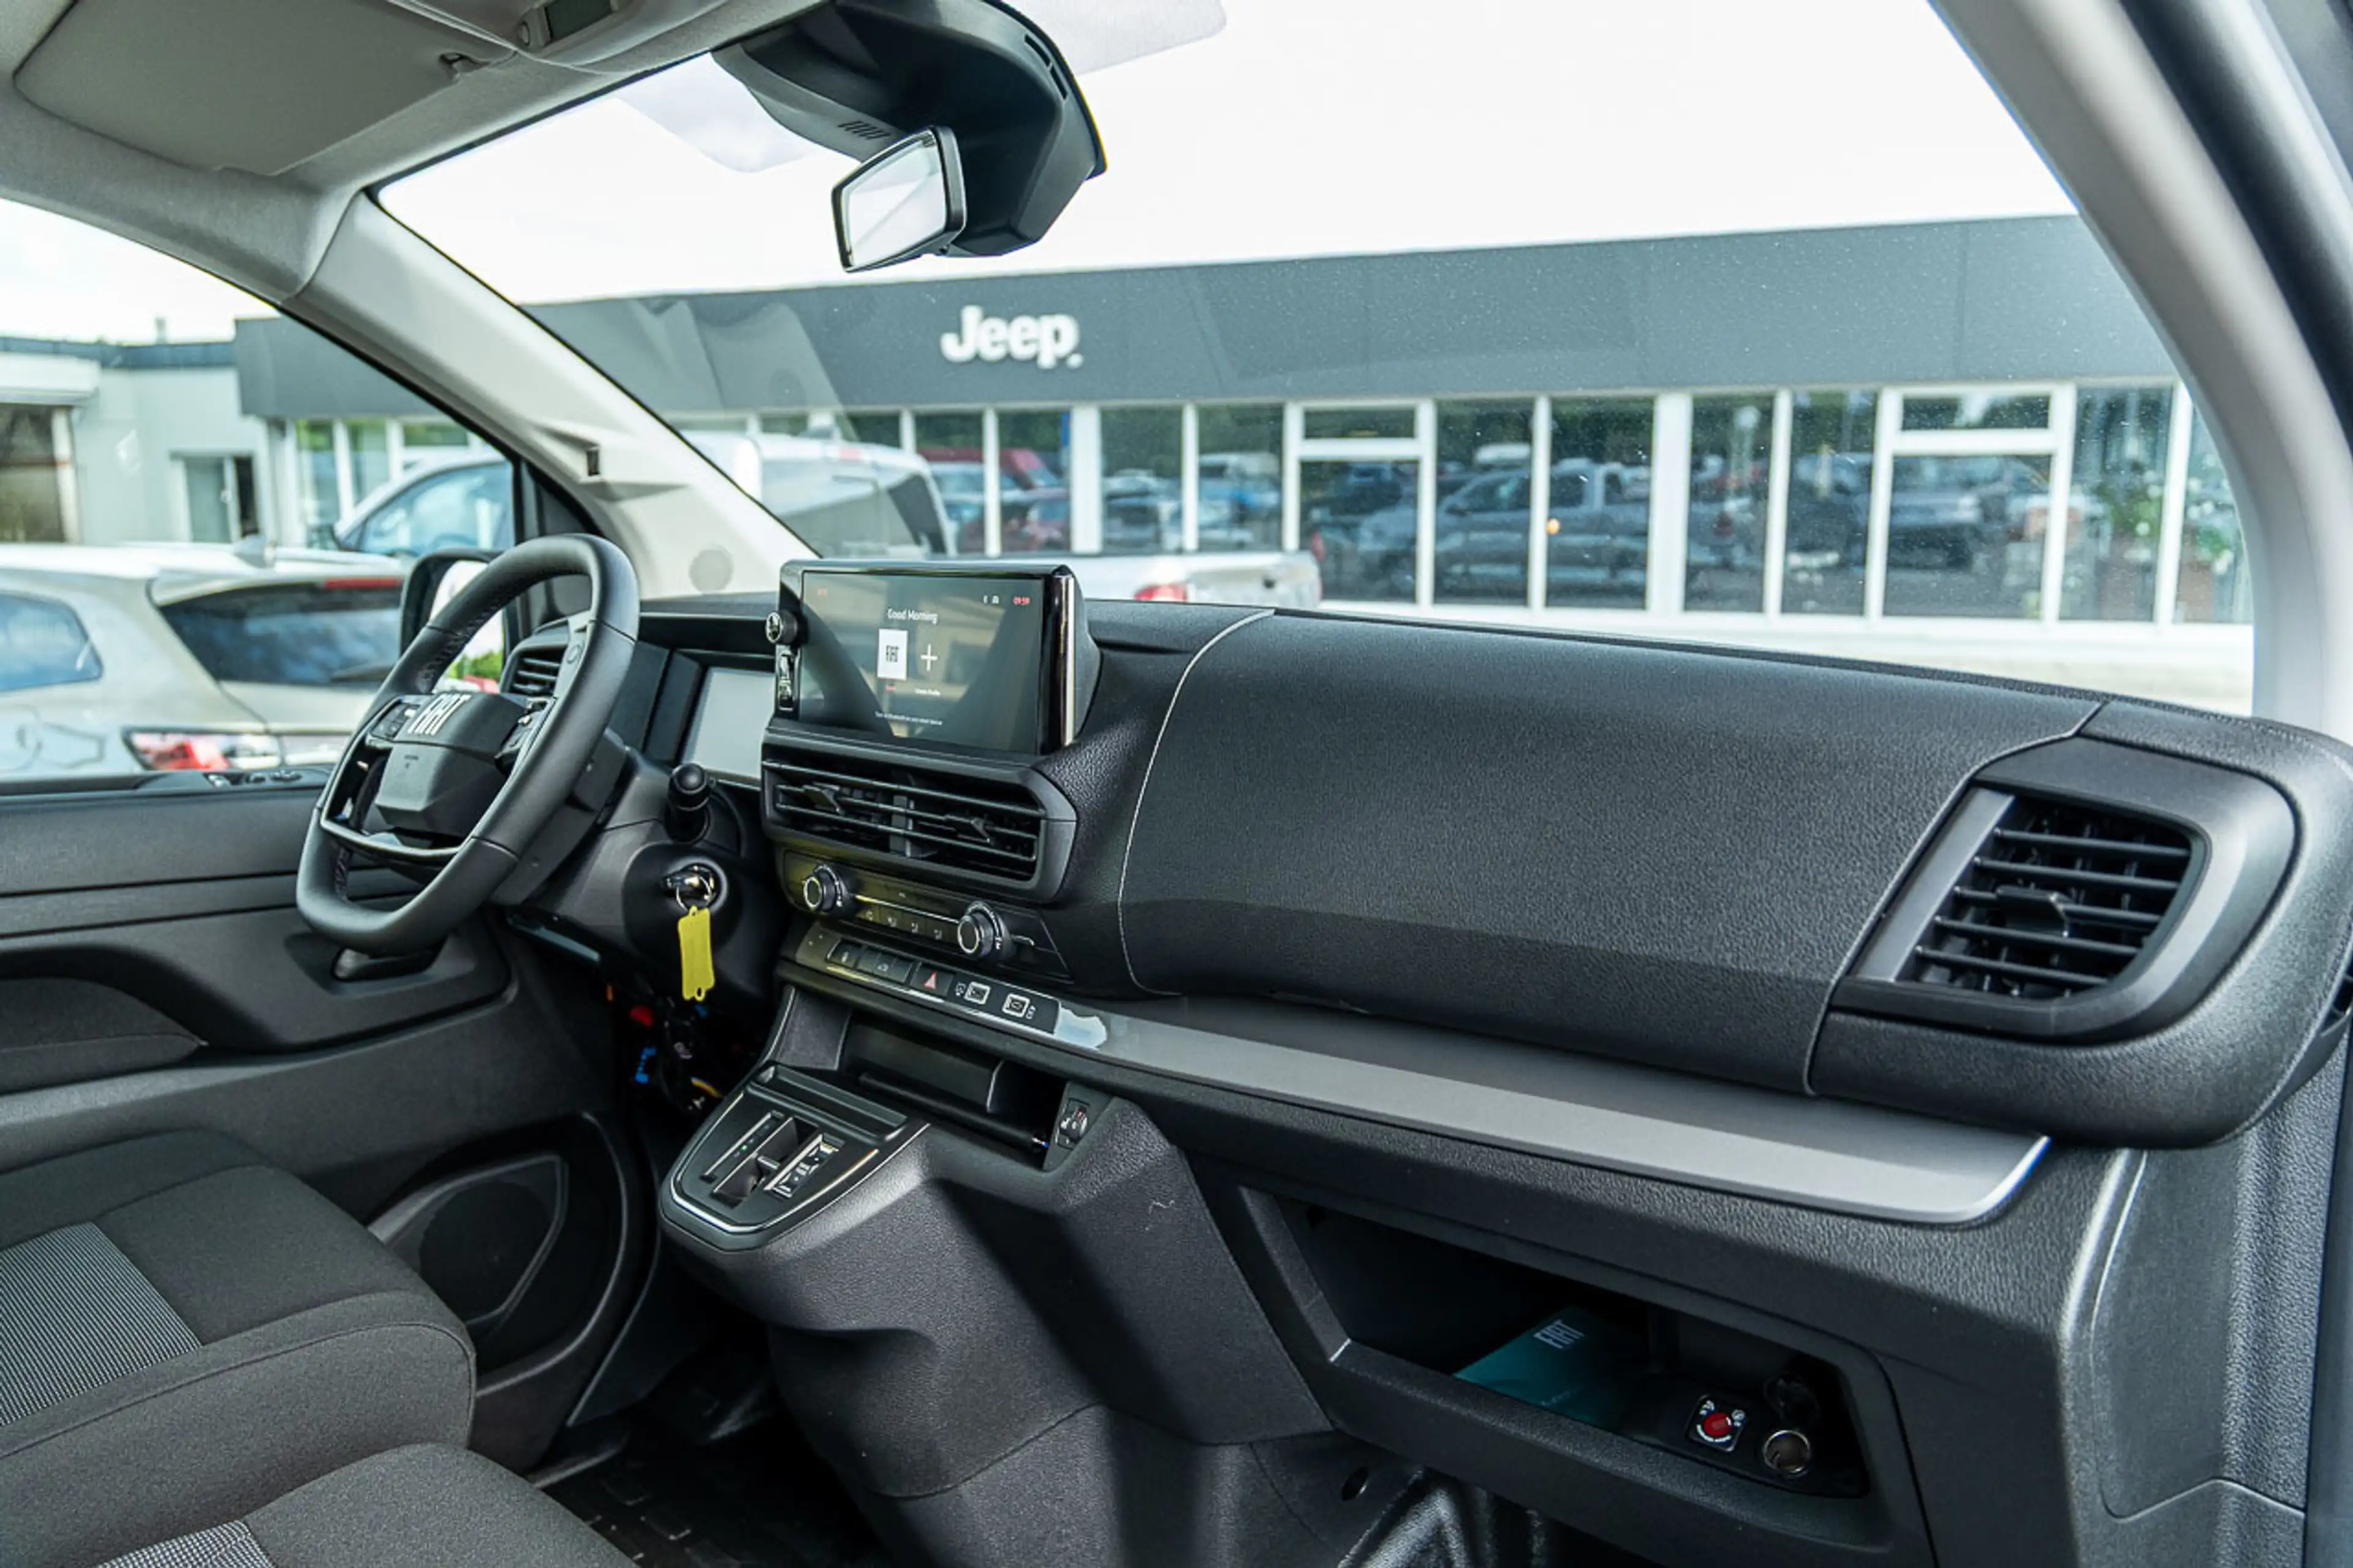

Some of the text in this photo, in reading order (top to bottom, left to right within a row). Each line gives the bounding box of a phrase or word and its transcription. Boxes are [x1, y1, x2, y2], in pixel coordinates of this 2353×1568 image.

[887, 608, 939, 625] Good Morning
[407, 693, 472, 736] FIAT
[1532, 1319, 1586, 1350] FIAT
